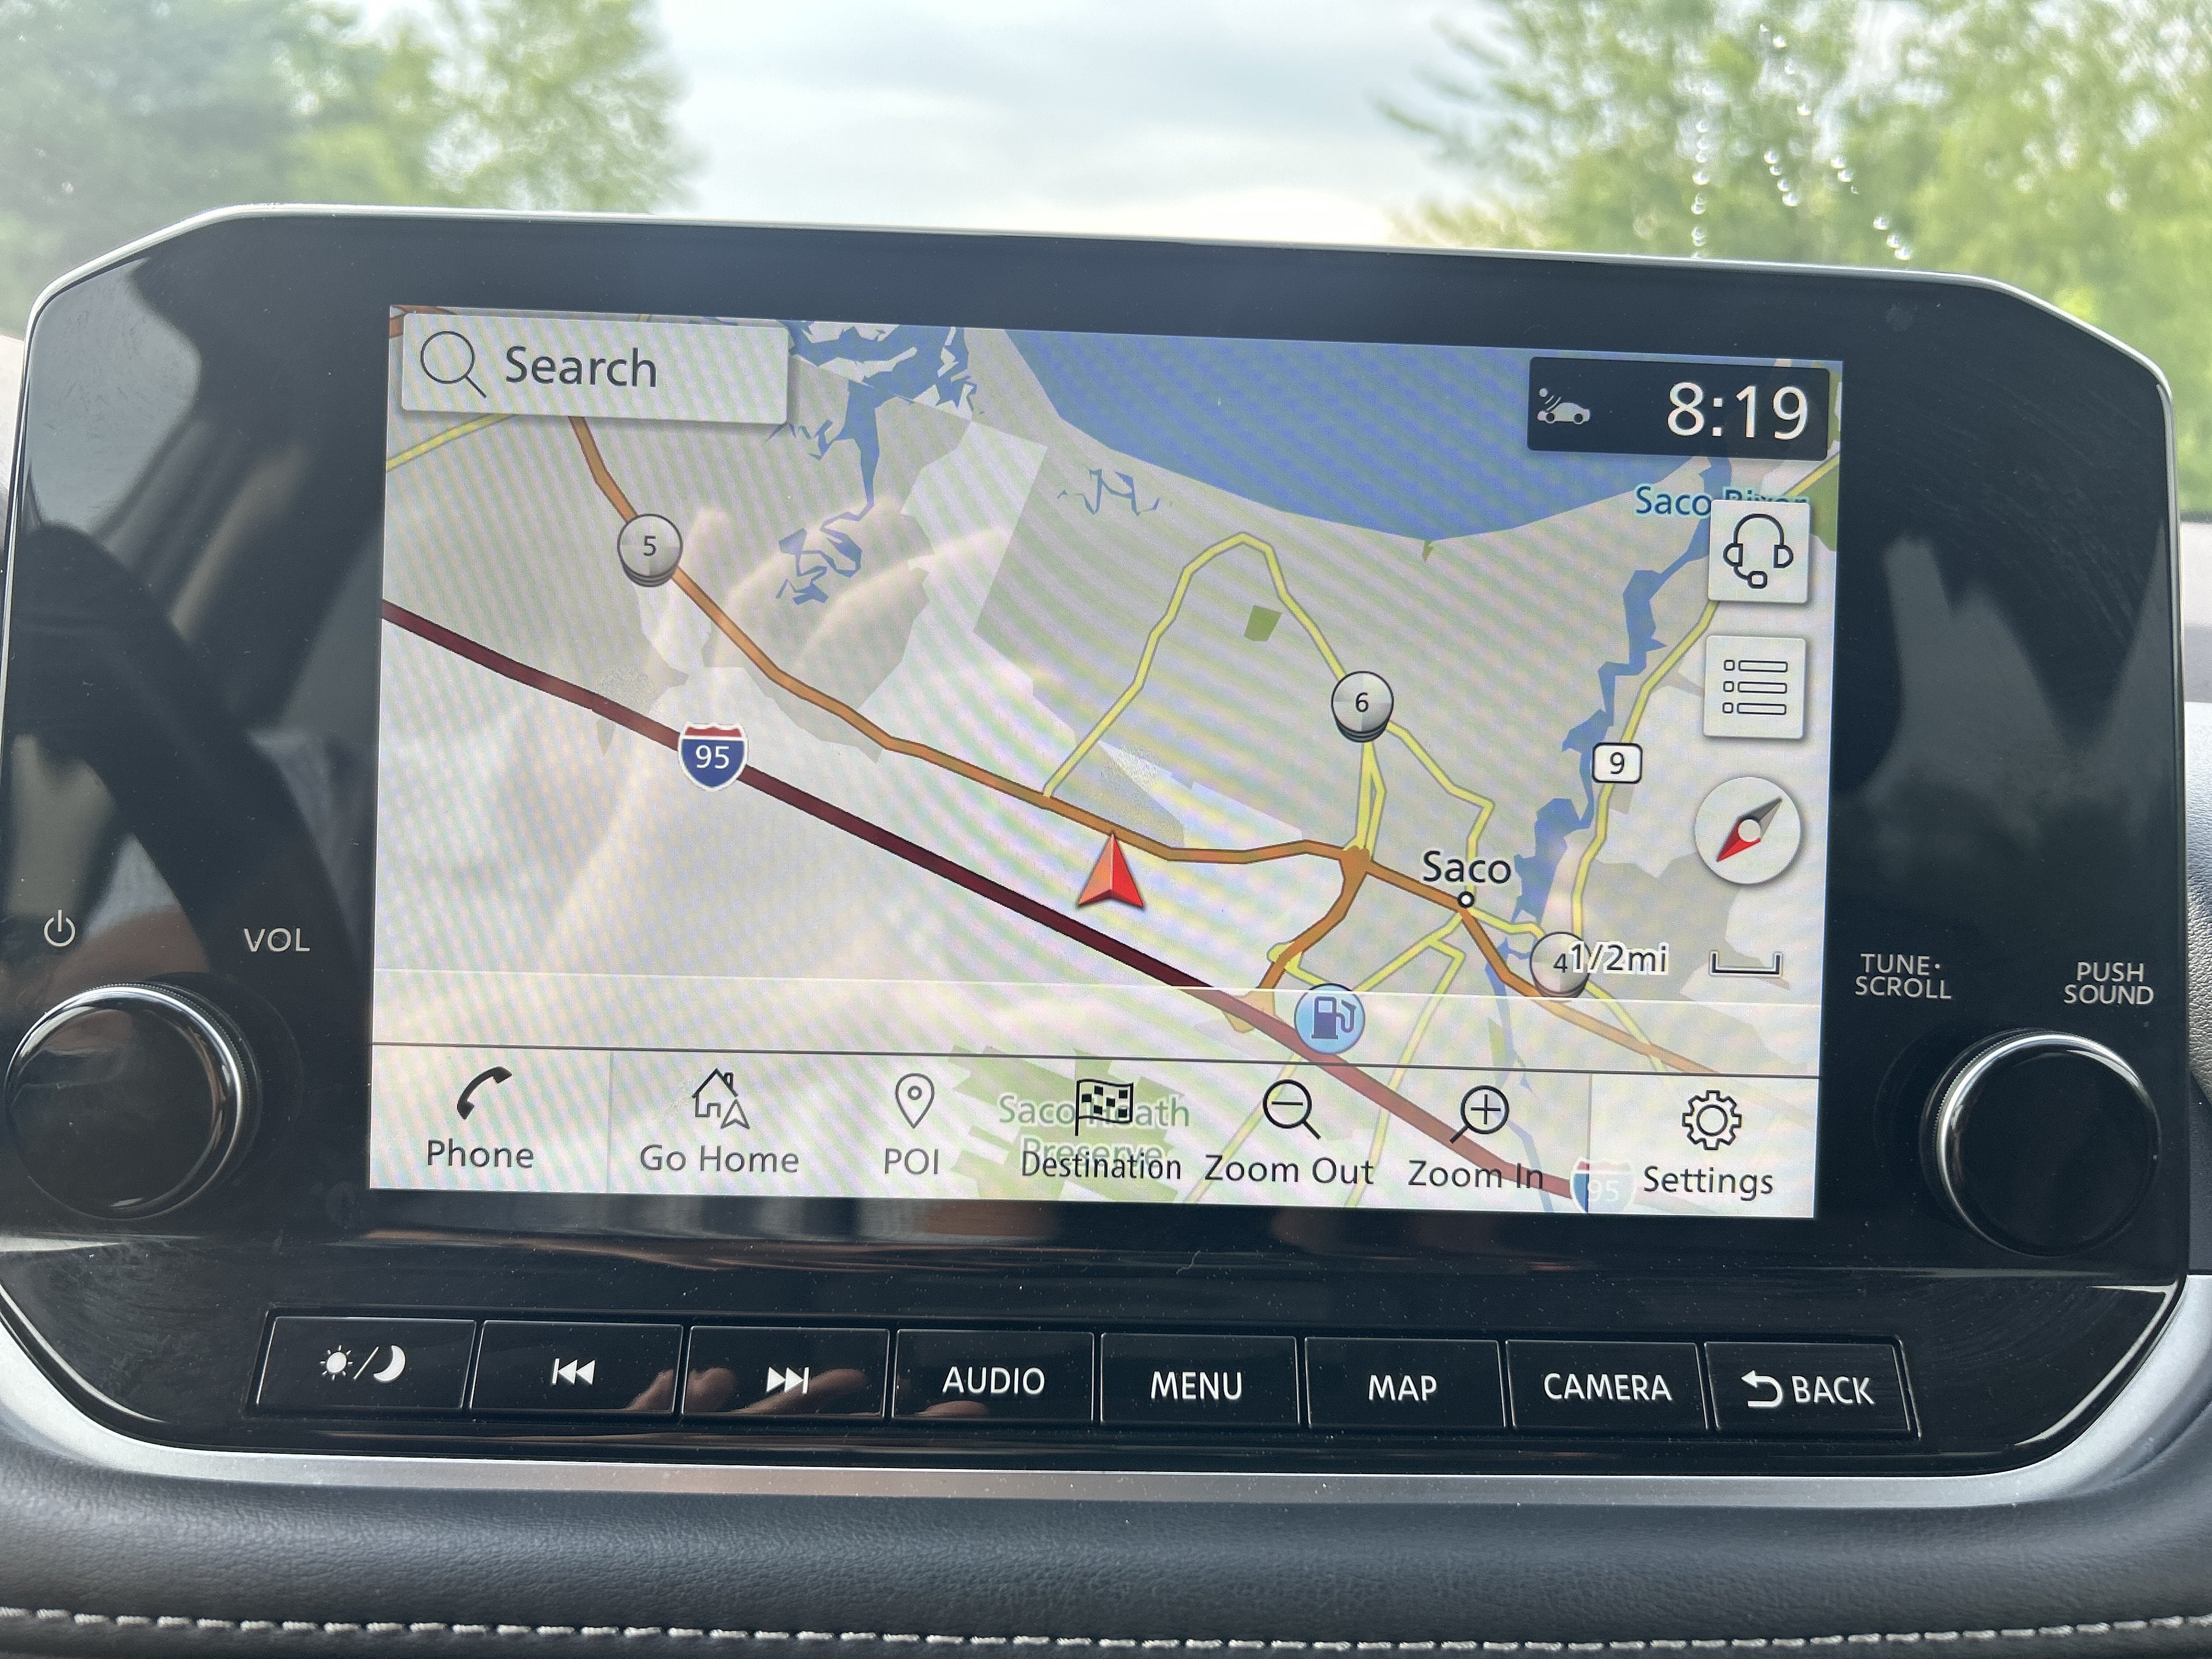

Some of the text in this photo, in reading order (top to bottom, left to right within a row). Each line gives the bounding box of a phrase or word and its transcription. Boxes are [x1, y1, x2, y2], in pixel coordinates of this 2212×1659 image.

[505, 346, 657, 388] Search
[1666, 381, 1809, 441] 8:19
[1635, 486, 1712, 516] Saco
[642, 535, 657, 557] 5
[1355, 691, 1369, 713] 6
[695, 744, 730, 769] 95
[1610, 751, 1625, 775] 9
[1423, 851, 1511, 883] Saco
[244, 927, 310, 952] VOL
[1571, 943, 1666, 973] 1/2mi
[2076, 962, 2144, 982] PUSH
[1855, 975, 1952, 1000] SCROLL
[2063, 984, 2154, 1005] SOUND
[999, 1094, 1075, 1124] Saco
[427, 1138, 534, 1169] Phone
[639, 1144, 799, 1173] Go Home
[884, 1148, 939, 1175] POI
[1022, 1150, 1181, 1180] Destination
[1204, 1154, 1374, 1184] Zoom Out
[1407, 1160, 1543, 1190] Zoom In
[1644, 1166, 1773, 1201] Settings
[942, 1366, 1046, 1395] AUDIO
[1150, 1370, 1243, 1400] MENU
[1368, 1374, 1437, 1401] MAP
[1543, 1373, 1672, 1401] CAMERA
[1793, 1376, 1875, 1404] BACK
